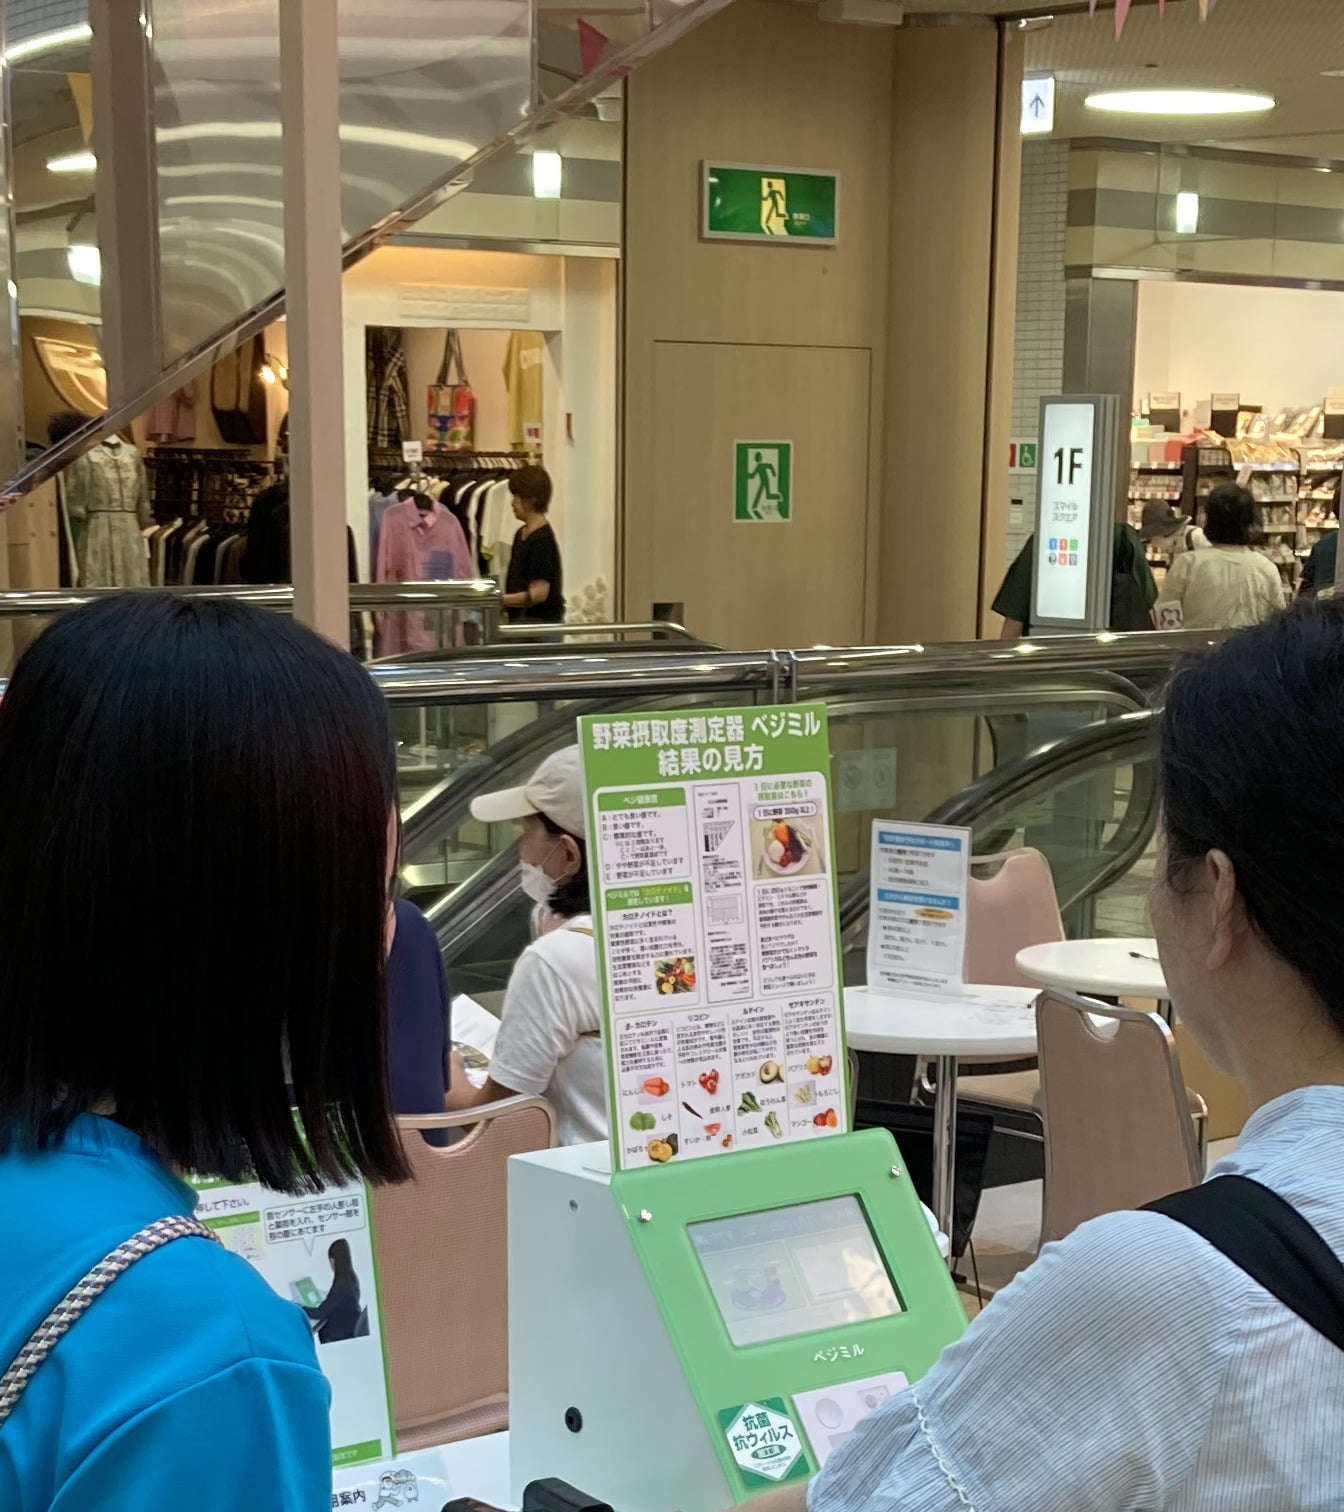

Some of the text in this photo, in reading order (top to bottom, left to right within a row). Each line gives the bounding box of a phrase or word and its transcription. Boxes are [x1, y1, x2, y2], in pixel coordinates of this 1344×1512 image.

[1054, 447, 1084, 485] 1F
[592, 711, 821, 750] 野菜摂取度測定器 ベジミル
[658, 743, 765, 777] 結果の見方
[813, 1343, 865, 1362] ベジミル
[742, 1412, 772, 1432] 抗菌
[733, 1425, 794, 1452] 抗ウィルス
